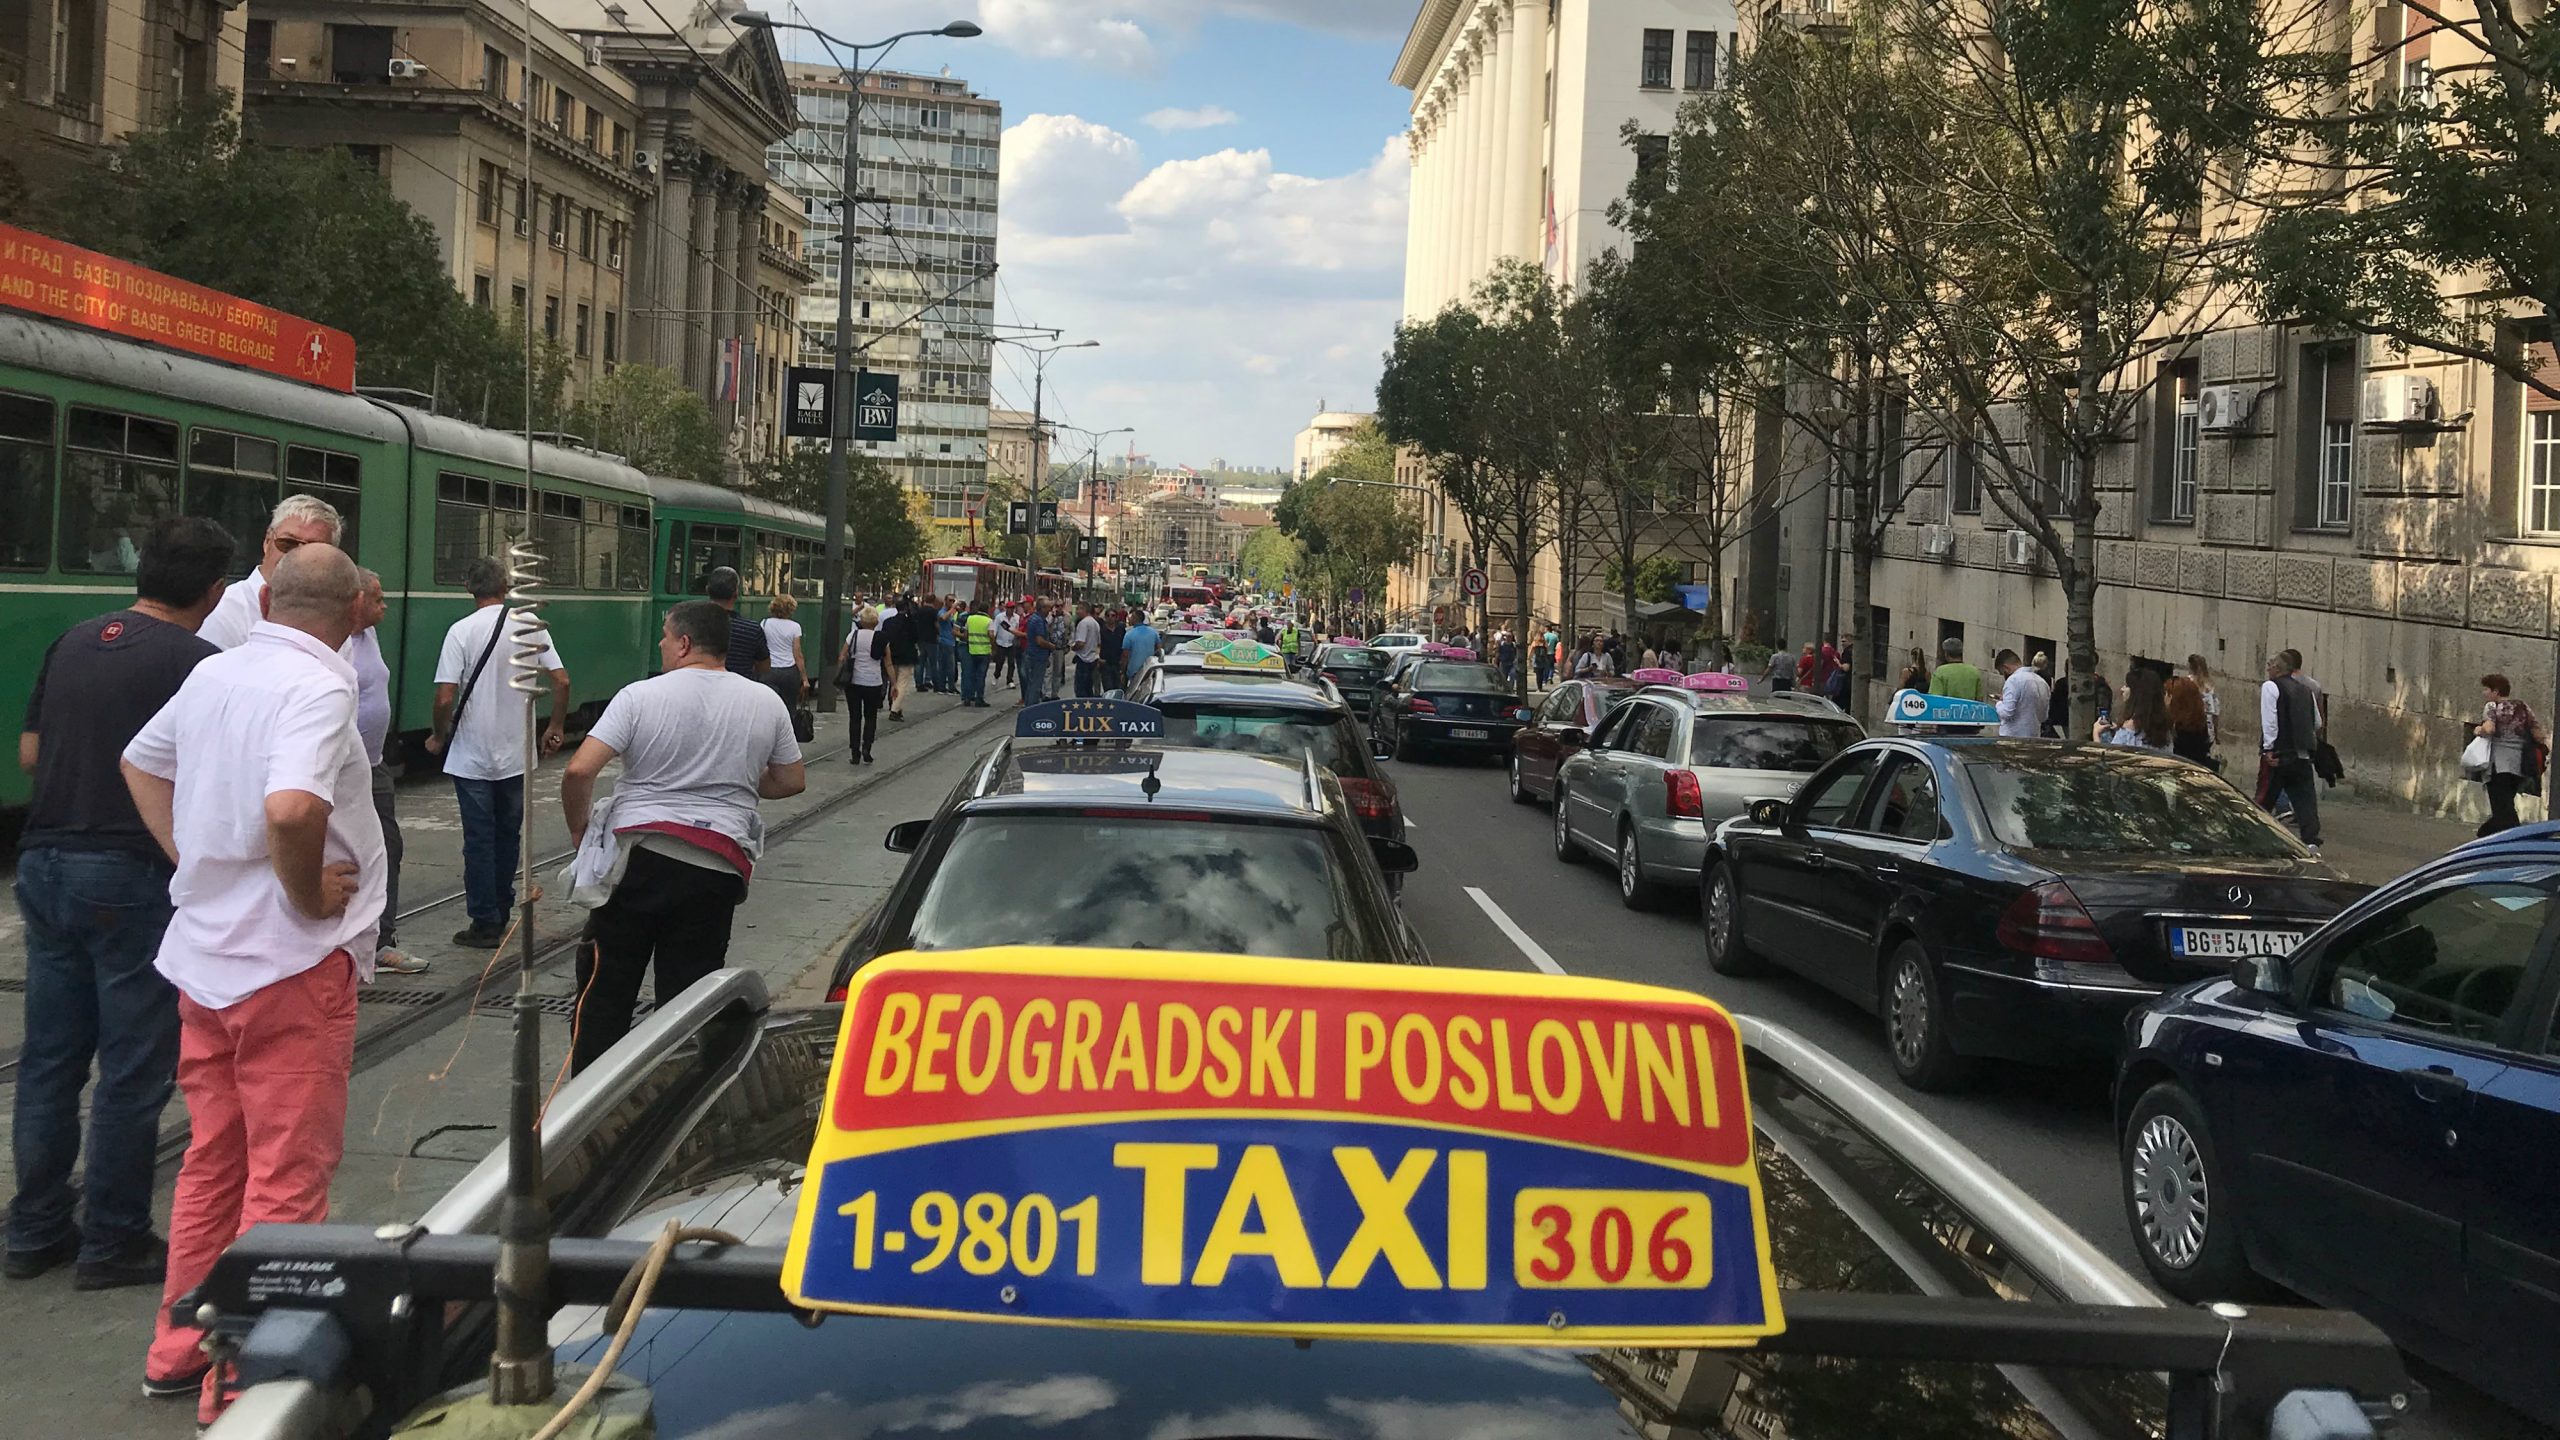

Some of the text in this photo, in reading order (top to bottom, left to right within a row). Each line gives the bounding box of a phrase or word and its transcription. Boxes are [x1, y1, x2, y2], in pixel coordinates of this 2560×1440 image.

[4, 240, 278, 337] И ГРАД БАЗЕЛ ПОЗДРАВЉАЈУ БЕОГРАД
[0, 274, 276, 362] AND THE CITY OF BASEL GREET BELGRADE
[798, 410, 823, 418] EAGLE
[863, 408, 890, 425] BW
[1231, 649, 1258, 660] TAXI
[1727, 679, 1742, 687] 503
[1904, 700, 1926, 709] 1406
[1062, 710, 1115, 732] Lux
[1120, 721, 1155, 732] TAXI
[2186, 930, 2211, 953] BG
[863, 992, 1720, 1129] BEOGRADSKI POSLOVNI
[838, 1142, 1694, 1290] 1-9801 TAXI 306
